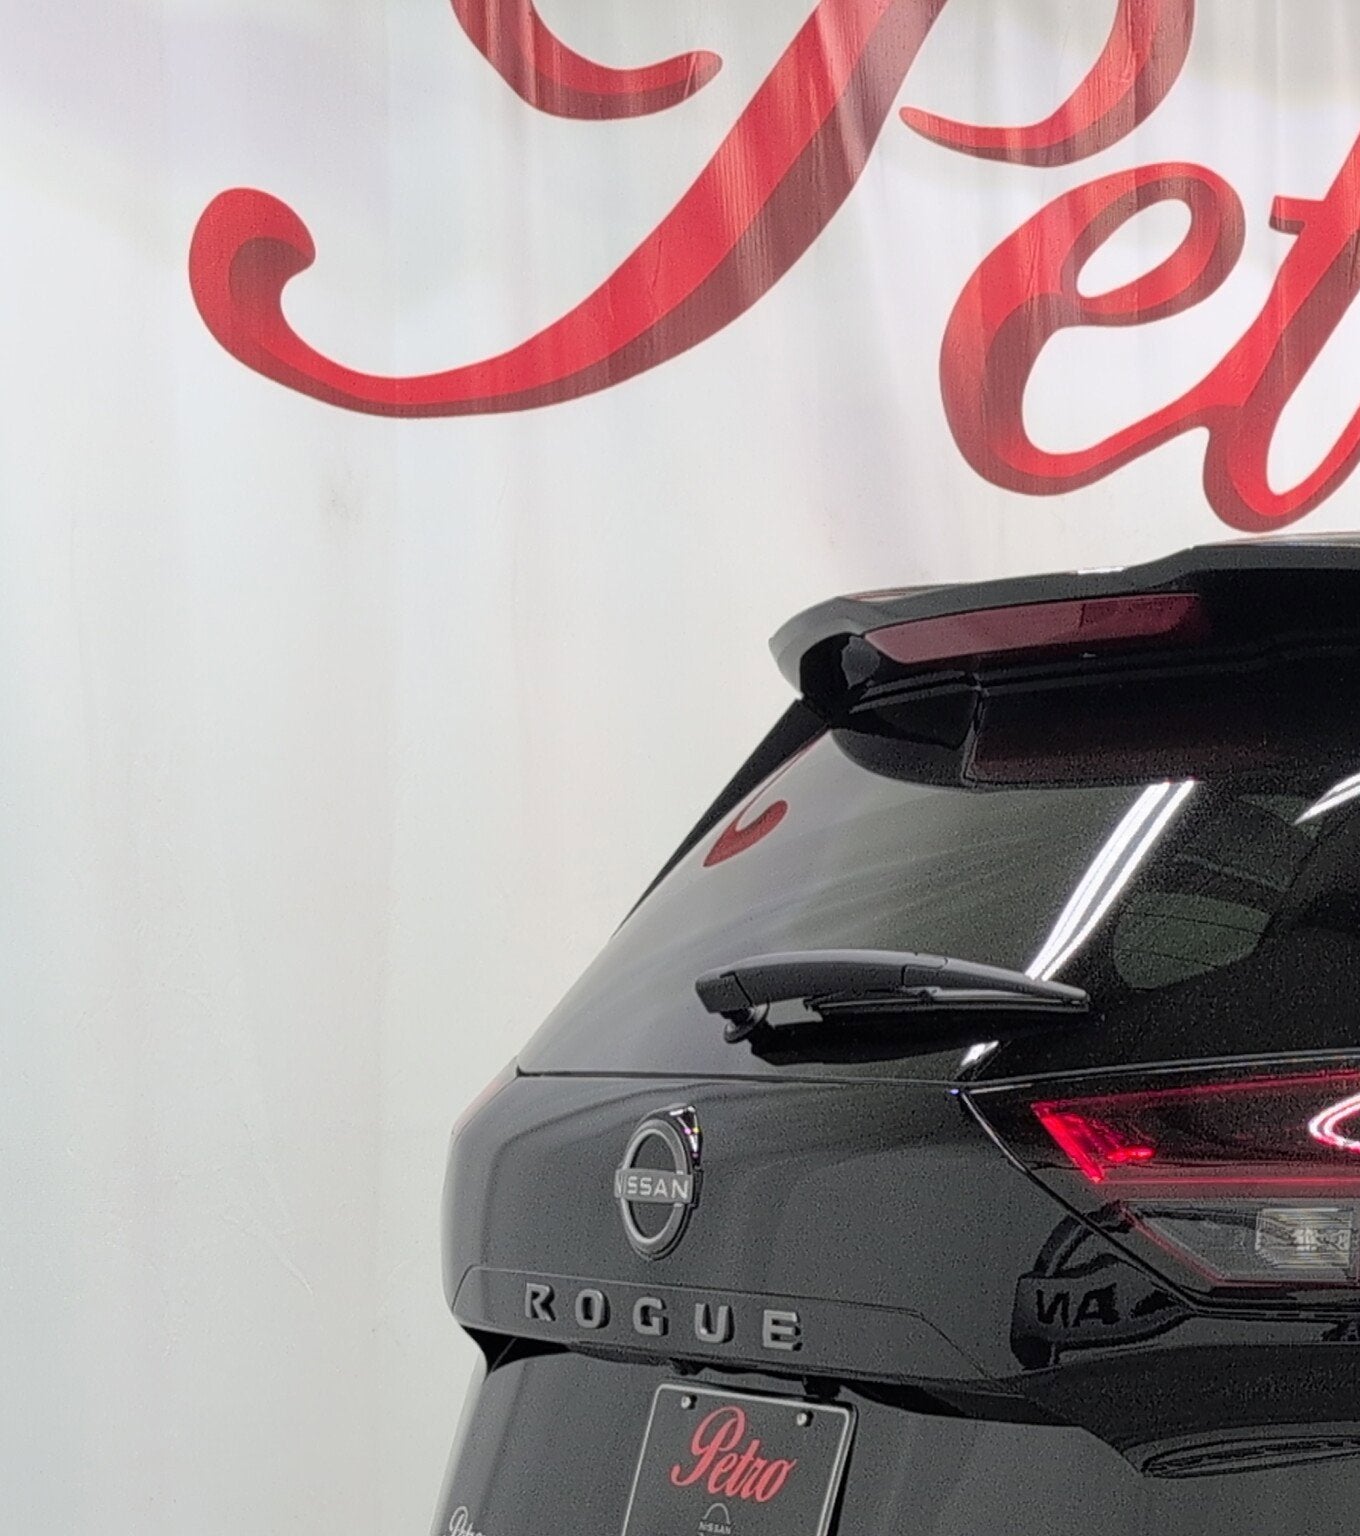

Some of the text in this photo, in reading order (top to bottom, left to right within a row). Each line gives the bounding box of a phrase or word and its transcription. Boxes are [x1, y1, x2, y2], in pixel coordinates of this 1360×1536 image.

[615, 1173, 690, 1200] NISSAN
[524, 1282, 803, 1351] ROGUE
[670, 1405, 797, 1502] Petro
[699, 1520, 732, 1536] NISSAN
